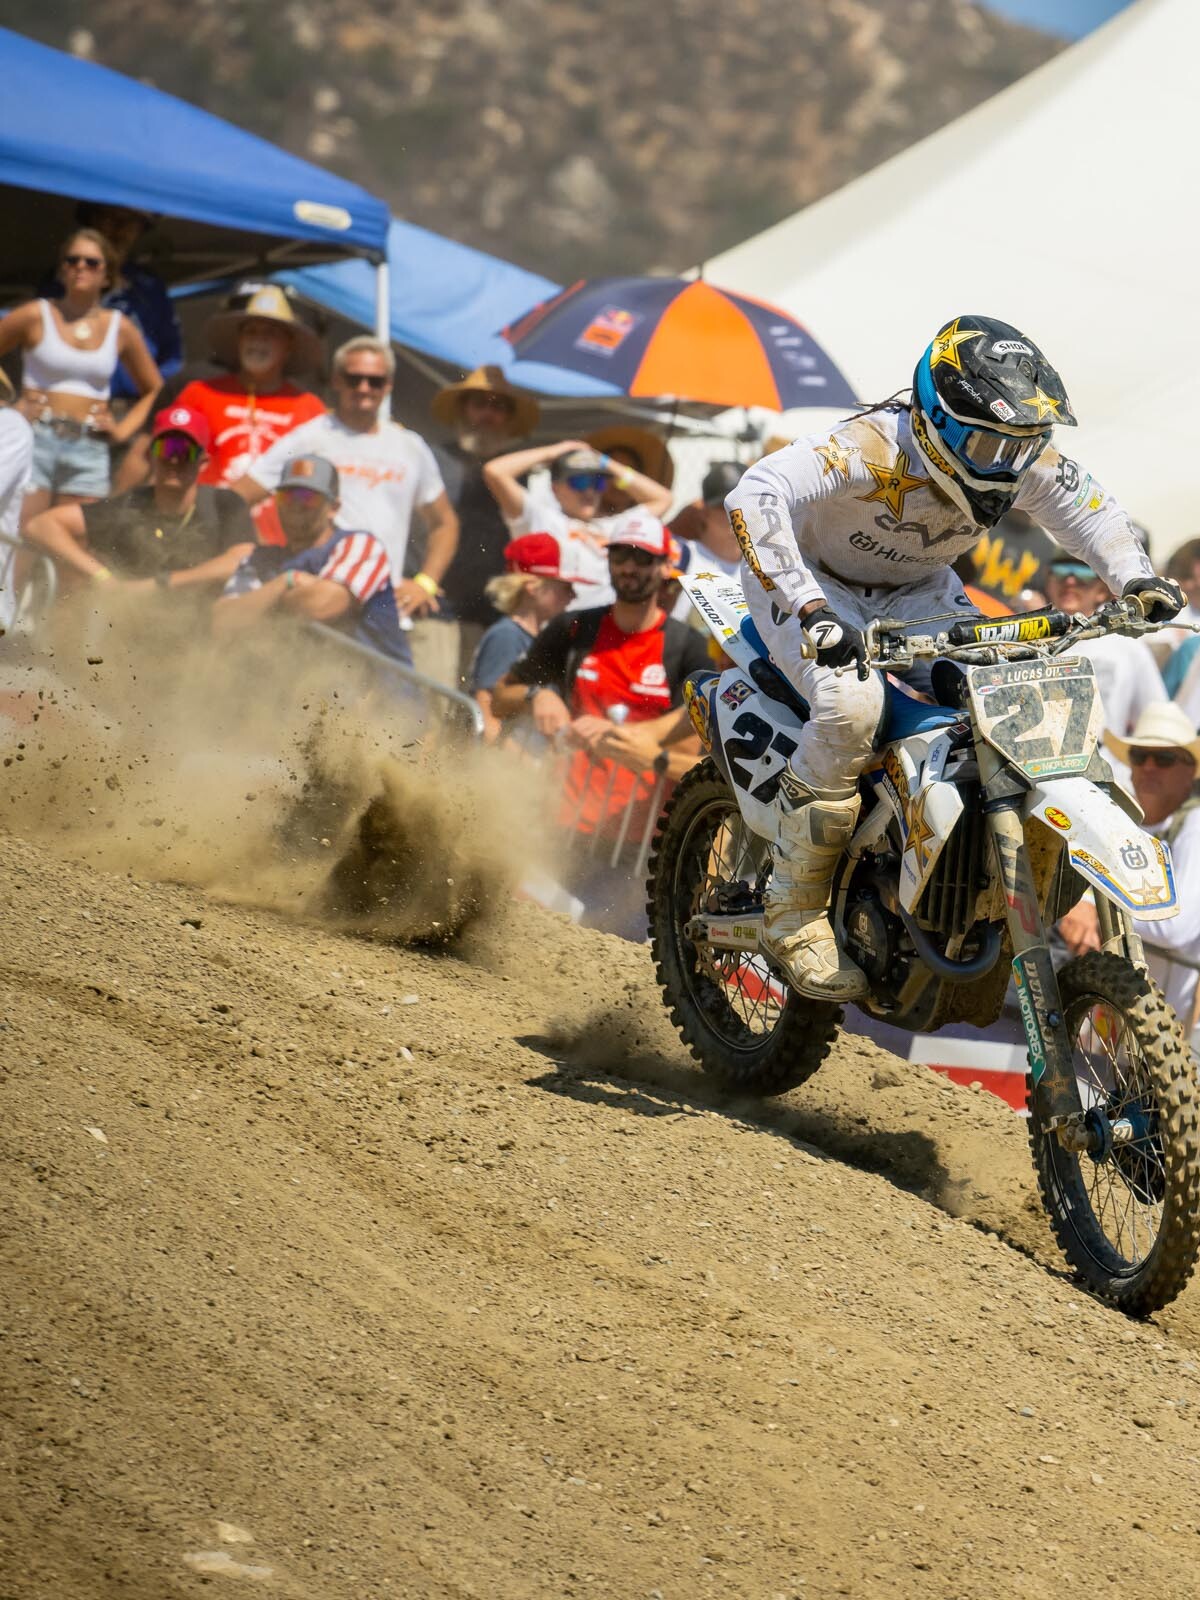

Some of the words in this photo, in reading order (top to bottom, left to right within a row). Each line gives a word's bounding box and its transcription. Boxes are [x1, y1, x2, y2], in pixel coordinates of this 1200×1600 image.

[691, 588, 725, 627] DUNLOP
[1007, 668, 1043, 683] LUCAS
[984, 677, 1095, 763] 27
[1045, 807, 1071, 830] FMF
[1017, 988, 1044, 1063] MOTOREX
